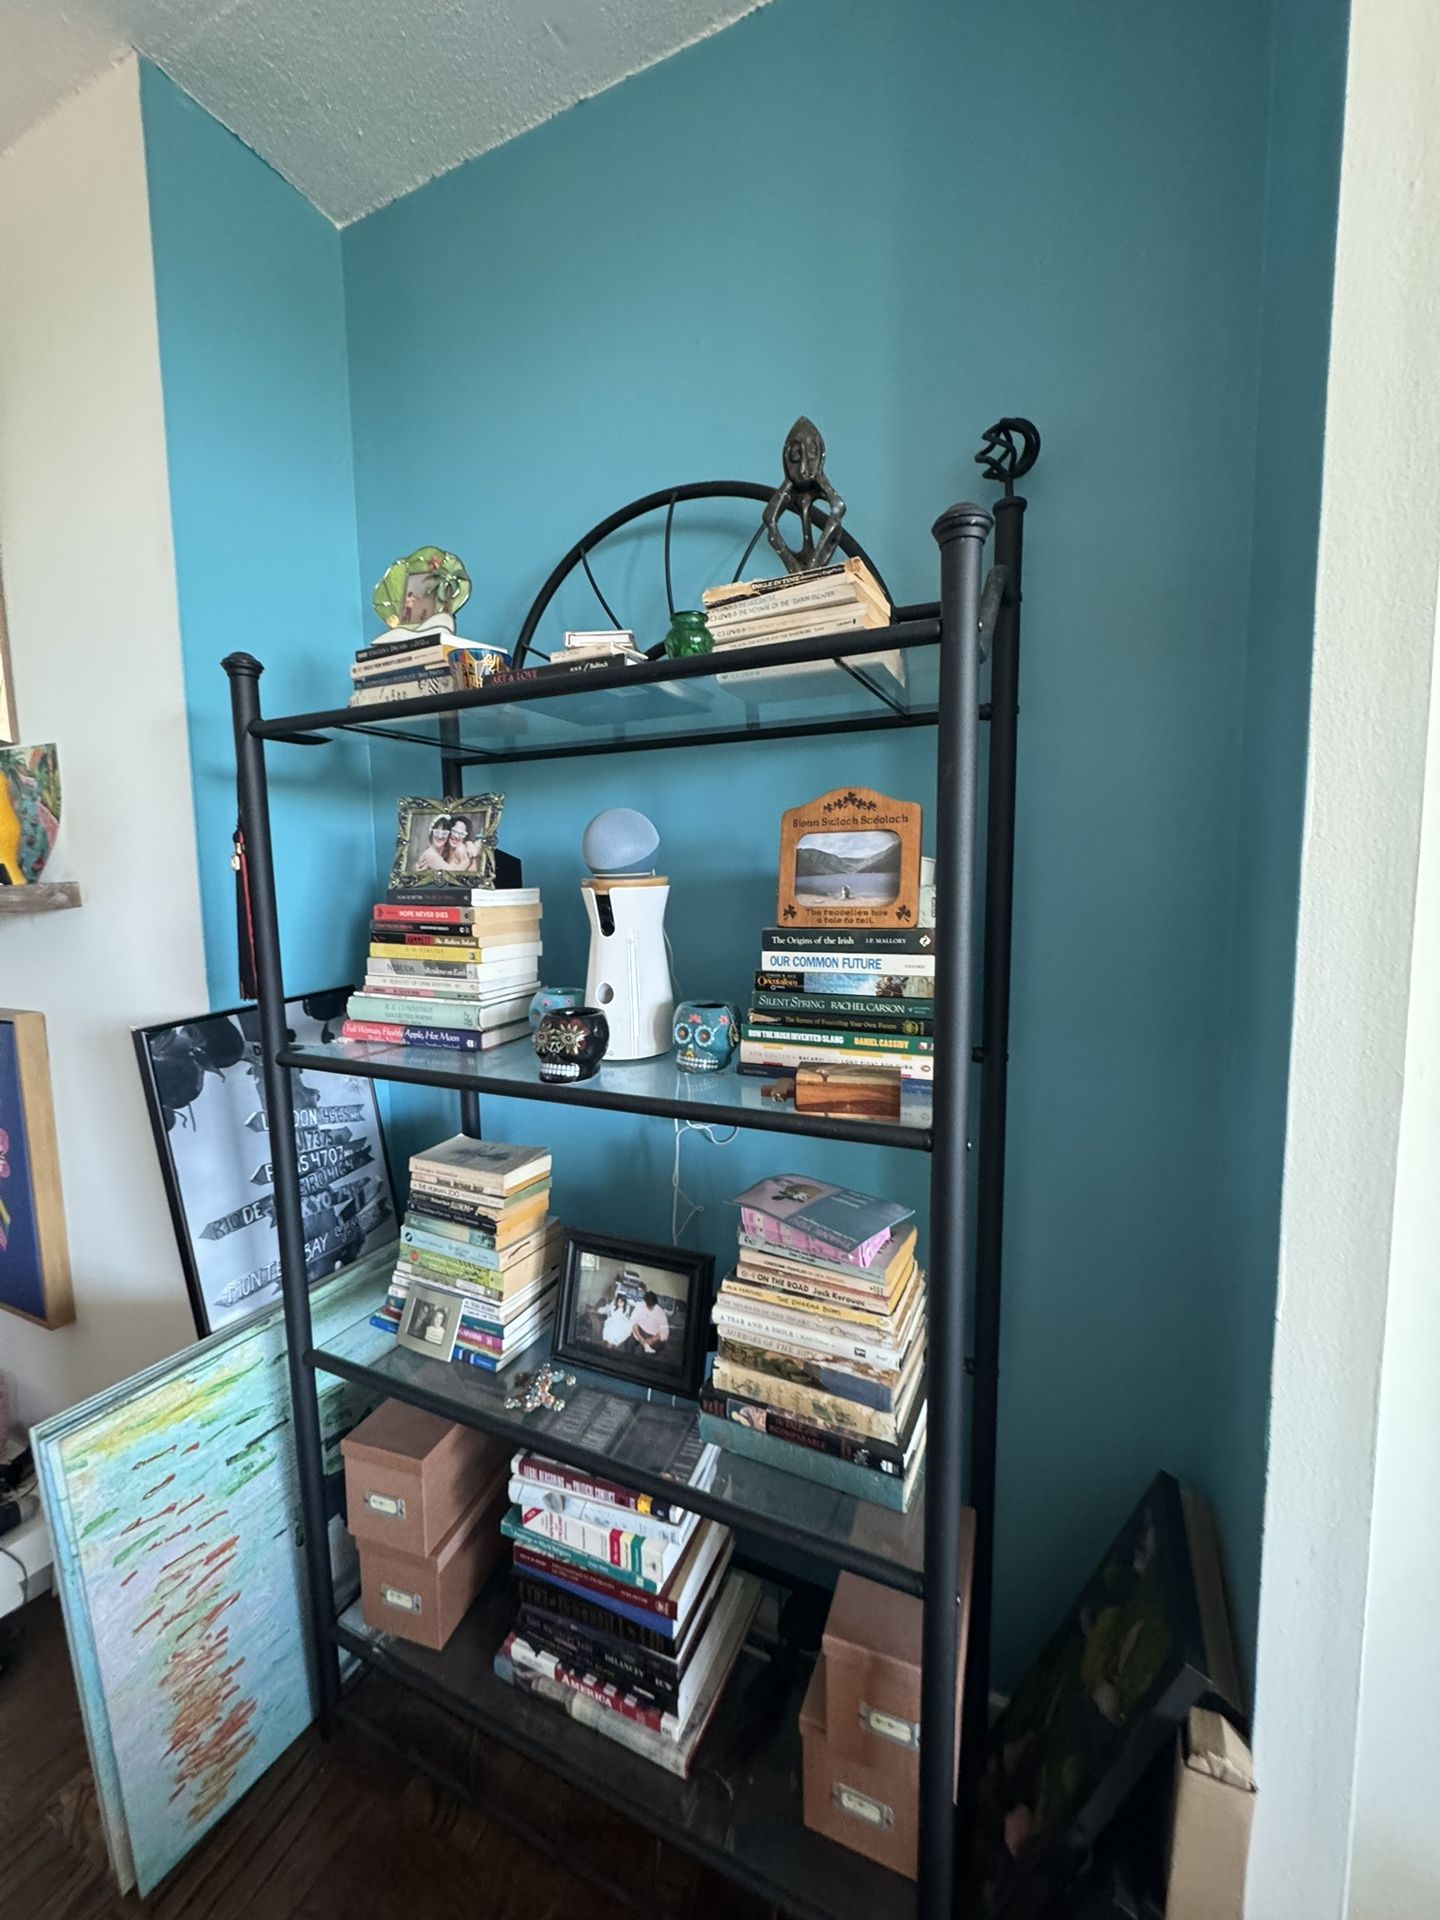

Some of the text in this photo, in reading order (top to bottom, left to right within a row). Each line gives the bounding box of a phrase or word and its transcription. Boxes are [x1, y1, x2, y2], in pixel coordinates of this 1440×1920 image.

[517, 669, 538, 682] LOVE
[399, 910, 415, 919] HOPE
[415, 910, 435, 919] NEVER
[435, 911, 449, 919] DIES
[824, 916, 842, 924] tale
[843, 916, 855, 924] to
[771, 936, 786, 945] The
[786, 936, 813, 946] Origins
[813, 936, 823, 944] of
[823, 937, 836, 945] the
[837, 936, 855, 945] Irish
[769, 955, 790, 967] OUR
[792, 956, 839, 968] COMMON
[841, 957, 882, 970] FUTURE
[758, 995, 792, 1008] SILENT
[791, 996, 826, 1010] SPRING
[830, 1001, 866, 1013] RACHEL
[866, 1003, 906, 1015] CARSON
[439, 1031, 460, 1043] Moon
[789, 1032, 823, 1043] INVENTED
[822, 1034, 845, 1045] SLANG
[878, 1038, 910, 1050] CASSIDY
[310, 1145, 344, 1168] 4707
[447, 1189, 460, 1198] ZOO
[241, 1201, 264, 1225] DE
[757, 1274, 866, 1308] ON THE ROAD Jack Kerouac
[776, 1295, 790, 1305] THE
[791, 1298, 820, 1311] DHARMA
[747, 1319, 764, 1330] AND
[781, 1341, 801, 1353] THE
[560, 1673, 614, 1708] AMERICA
